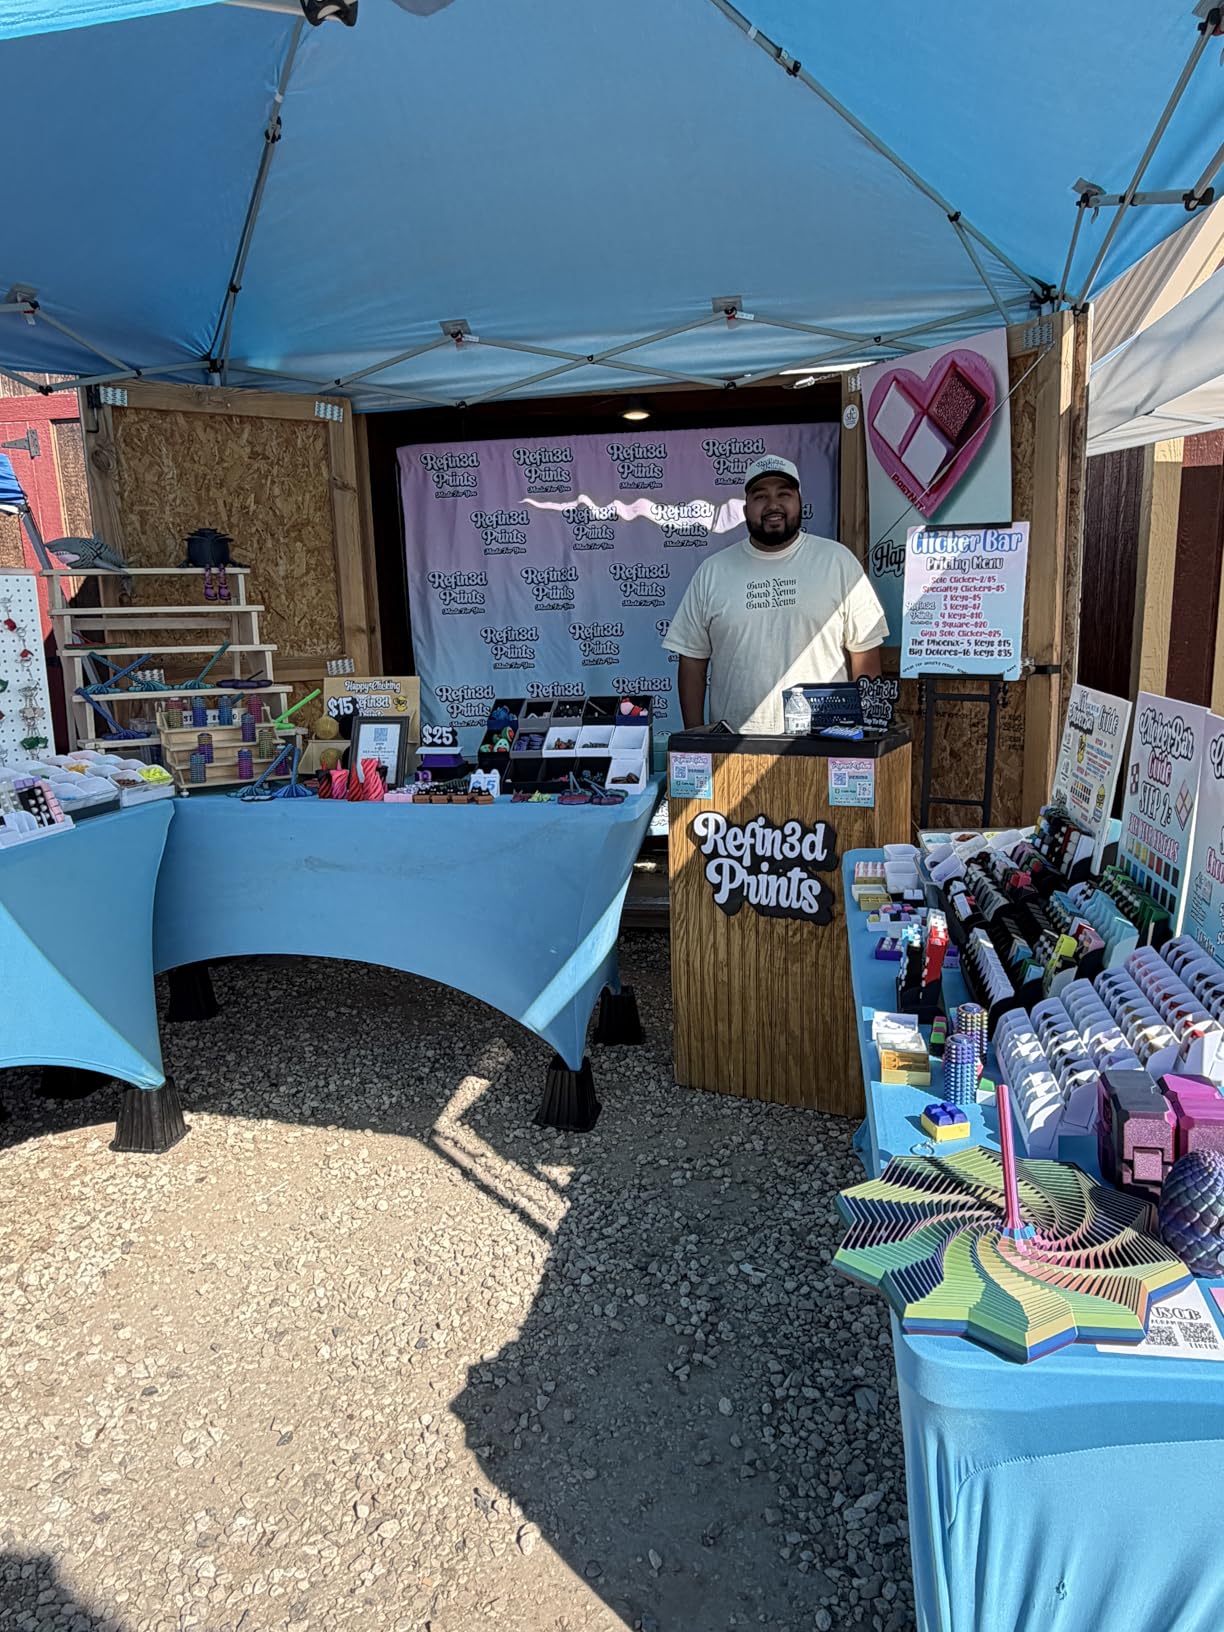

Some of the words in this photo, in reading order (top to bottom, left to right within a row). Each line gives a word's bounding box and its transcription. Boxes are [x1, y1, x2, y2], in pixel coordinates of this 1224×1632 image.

[512, 447, 574, 468] Refin3d
[606, 443, 667, 463] Refin3d
[702, 438, 766, 459] Refin3d
[421, 452, 480, 471] Refin3d
[712, 459, 754, 477] Print
[432, 471, 477, 489] Prints
[524, 467, 571, 484] Prints
[617, 463, 663, 480] Prints
[470, 510, 530, 529] Refin3d
[562, 505, 620, 523] Refin3d
[650, 501, 714, 521] Refin3d
[481, 528, 527, 545] Prints
[573, 523, 614, 540] Prints
[662, 522, 708, 539] Prints
[911, 530, 980, 555] Clicker
[982, 529, 1023, 554] Bar
[609, 563, 670, 582] Refin3d
[926, 556, 970, 575] Pricing
[971, 555, 1004, 571] Menu
[427, 571, 488, 590] Refin3d
[520, 566, 578, 585] Refin3d
[439, 589, 485, 606] Prints
[532, 584, 575, 602] Prints
[620, 581, 665, 599] Prints
[922, 585, 959, 595] Specialty
[943, 594, 948, 602] 2
[939, 612, 946, 620] 4
[943, 603, 948, 611] 3
[568, 622, 624, 642] Refin3d
[934, 621, 940, 630] 9
[480, 627, 539, 645] Refin3d
[911, 638, 926, 647] The
[926, 638, 964, 648] Phoenix-
[966, 638, 972, 647] 5
[996, 638, 1012, 648] $15
[490, 644, 535, 661] Prints
[578, 640, 620, 657] Prints
[908, 648, 923, 658] Big
[997, 648, 1013, 657] $35
[343, 680, 370, 694] Happy
[435, 685, 496, 703] Refin3d
[526, 681, 586, 699] Refin3d
[612, 676, 672, 694] Refin3d
[857, 677, 899, 701] Refin3d
[327, 696, 354, 718] $15
[355, 694, 390, 709] efin3d
[860, 698, 893, 720] Prints
[447, 703, 491, 719] Prints
[422, 725, 454, 746] $25
[1140, 707, 1174, 755] Clicker
[1170, 716, 1195, 763] Bar
[1147, 752, 1173, 788] Guide
[1139, 780, 1161, 821] STEP
[1161, 792, 1173, 828] 2:
[692, 812, 828, 867] Refin3d
[705, 858, 822, 915] Prints
